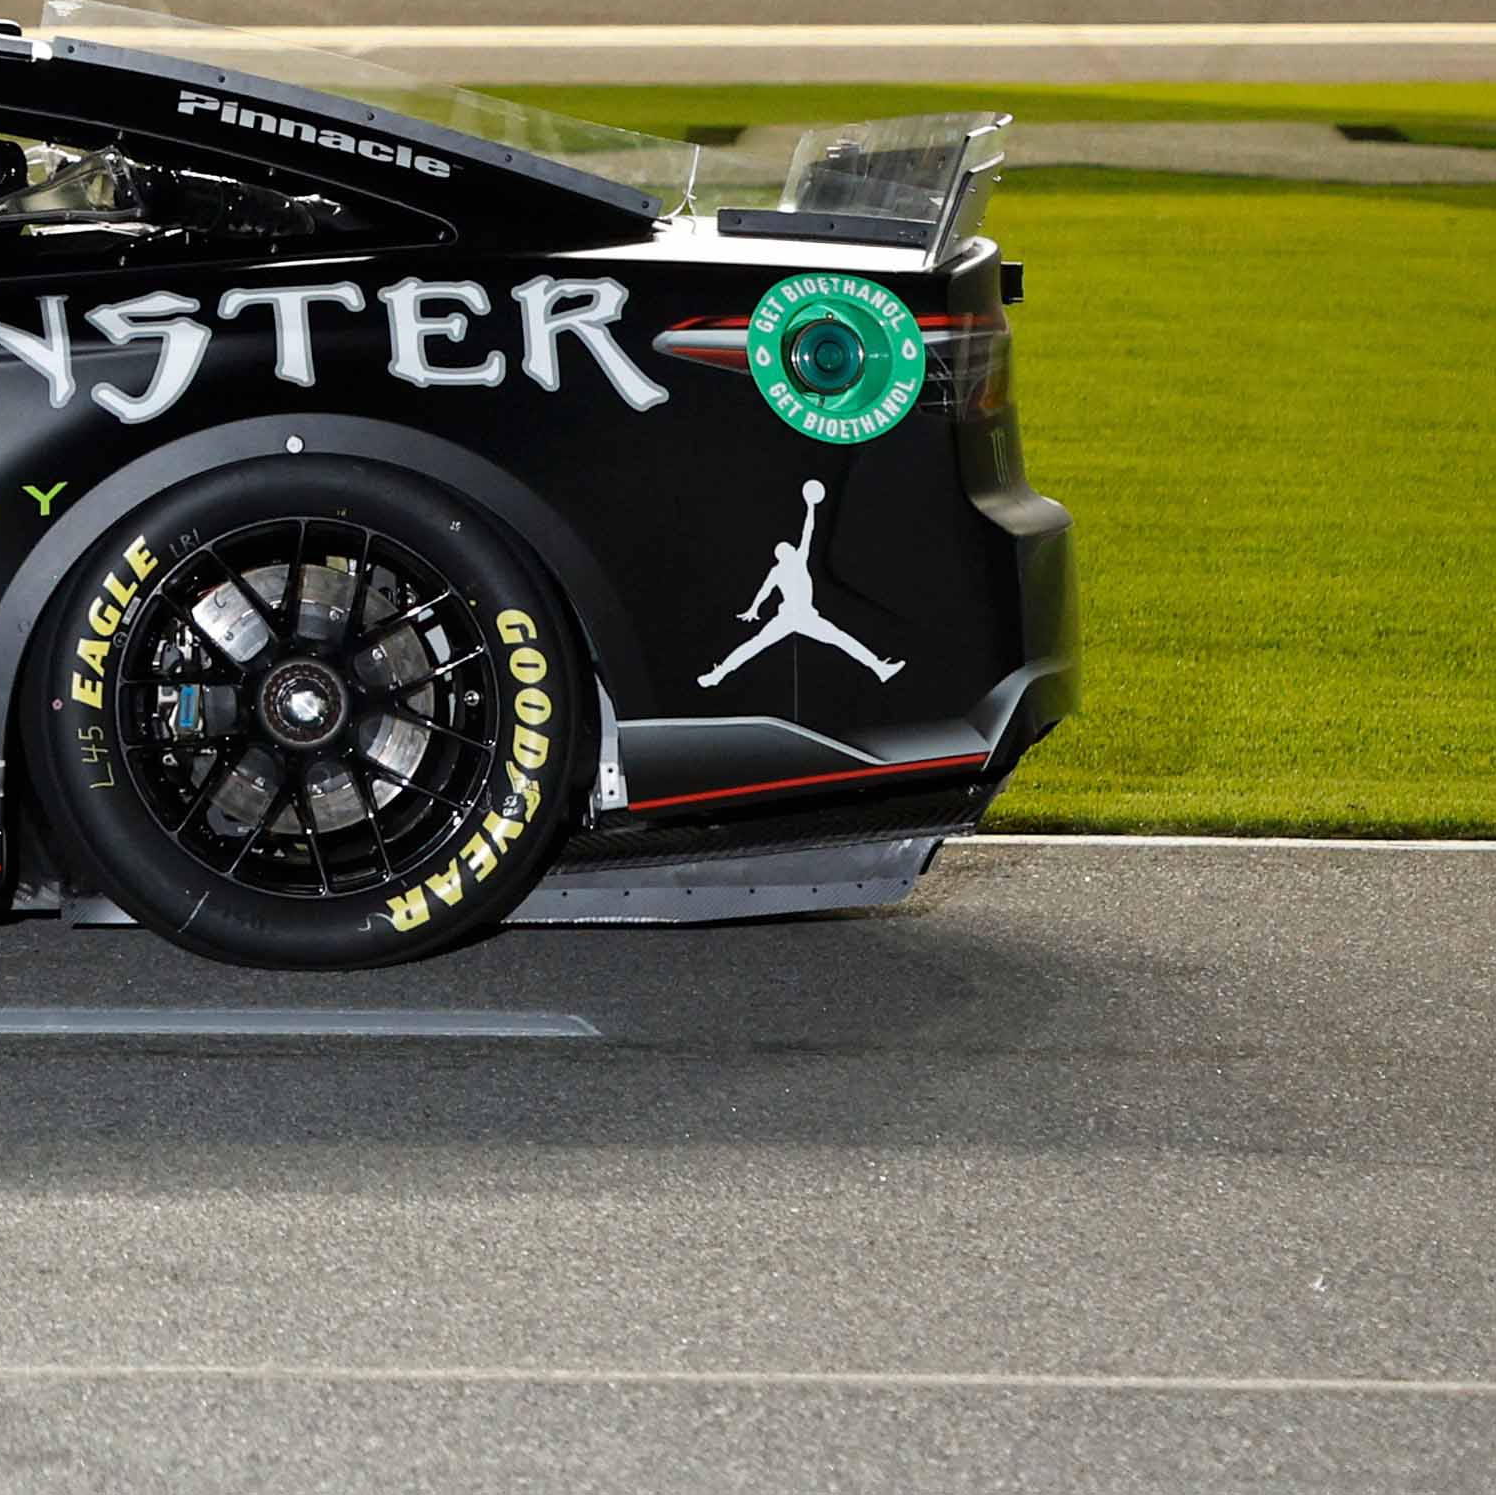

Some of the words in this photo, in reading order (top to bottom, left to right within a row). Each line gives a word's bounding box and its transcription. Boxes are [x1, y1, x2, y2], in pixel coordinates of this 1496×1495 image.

[176, 89, 452, 179] Pinnacle
[755, 296, 786, 333] GET
[780, 276, 907, 333] BIOETHANOL
[768, 381, 804, 418] GET
[803, 377, 917, 440] BIOETHANOL
[71, 534, 160, 710] EAGLE
[385, 608, 553, 933] GOODYEAR
